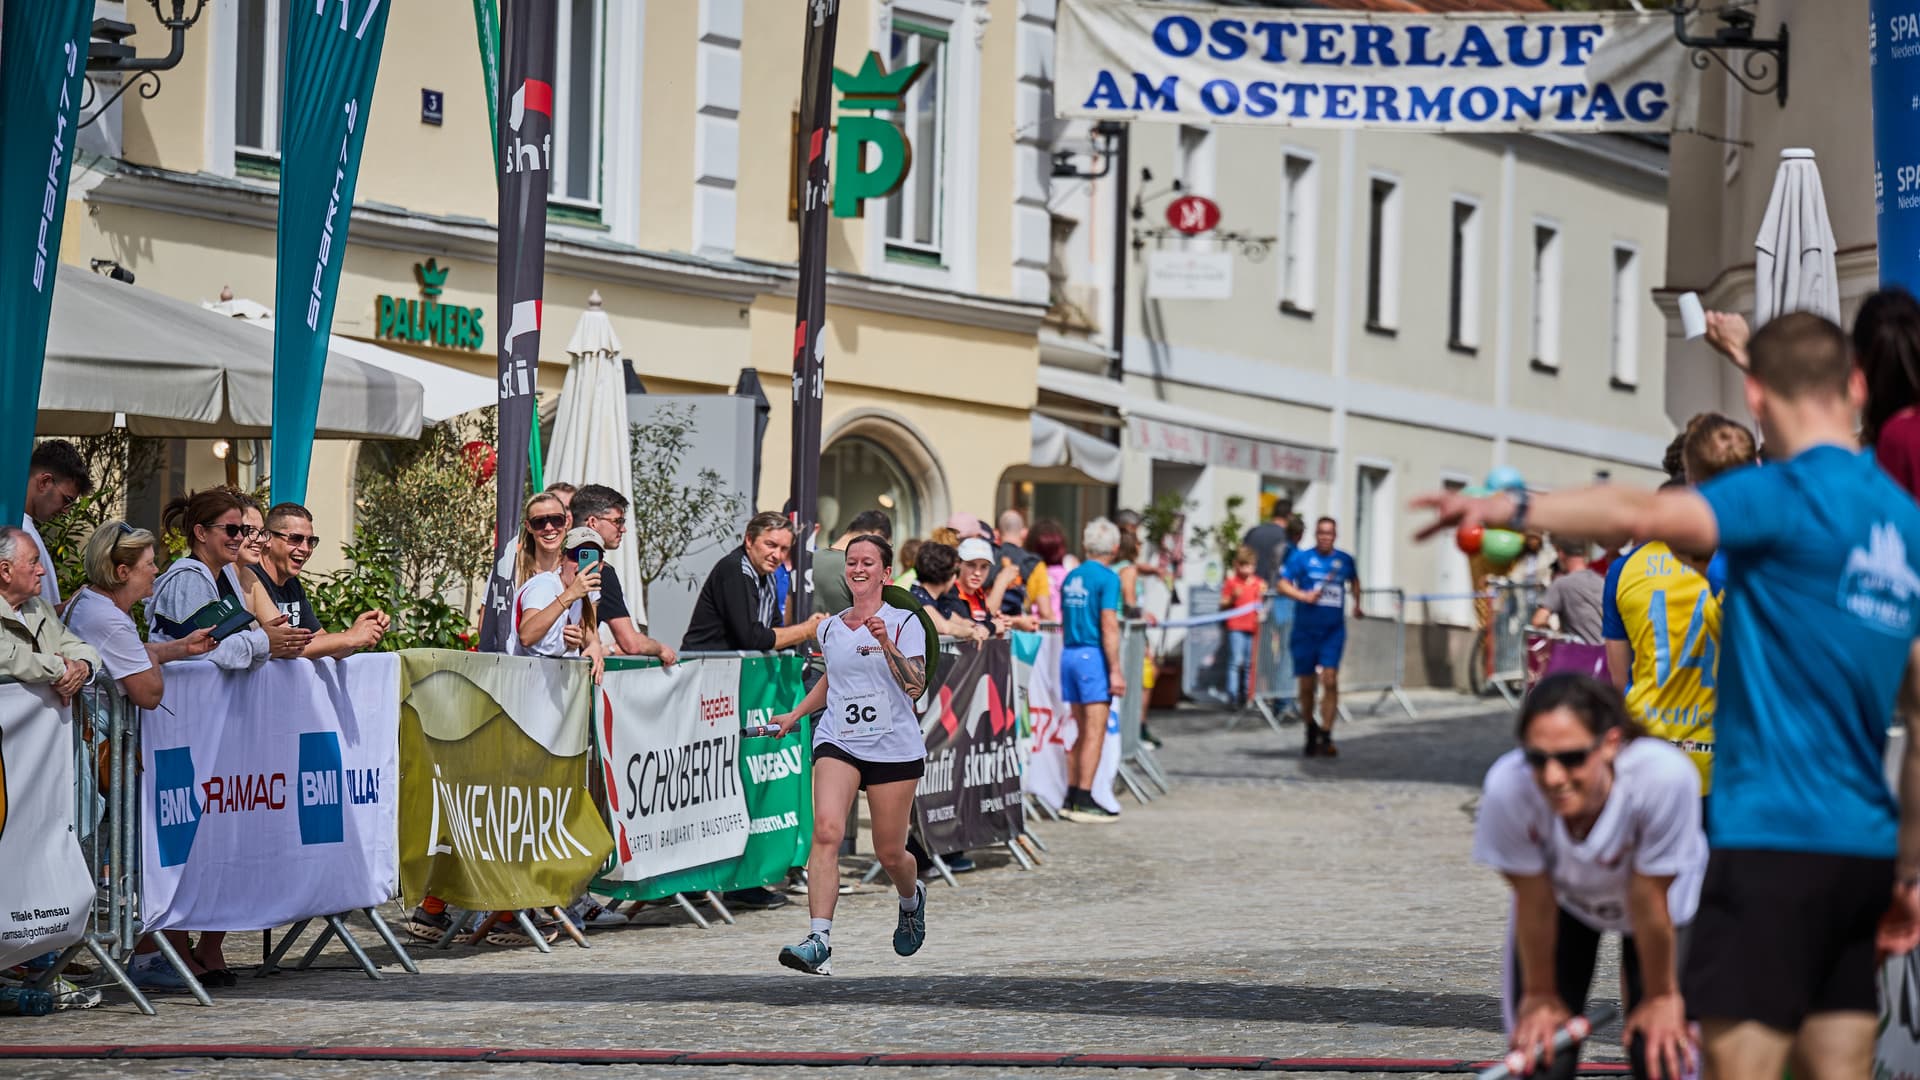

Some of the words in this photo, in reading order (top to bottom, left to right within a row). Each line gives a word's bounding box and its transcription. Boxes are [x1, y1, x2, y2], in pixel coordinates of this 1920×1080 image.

[1152, 15, 1603, 67] OSTERLAUF
[1890, 13, 1920, 41] SPA
[428, 94, 438, 111] 3
[1082, 69, 1180, 112] AM
[1201, 78, 1669, 122] OSTERMONTAG
[377, 294, 484, 349] PALMERS
[1648, 588, 1716, 688] 14
[700, 691, 734, 726] hagebau
[201, 773, 286, 814] RAMAC
[302, 770, 338, 806] BMI
[627, 735, 736, 820] SCHUBERTH
[427, 763, 592, 863] LWENPARK
[628, 833, 653, 855] GARTEN
[660, 823, 694, 848] BAUMARKT
[701, 812, 745, 838] BAUSTOFFE
[11, 910, 33, 922] Filiale
[33, 906, 70, 920] Ramsau
